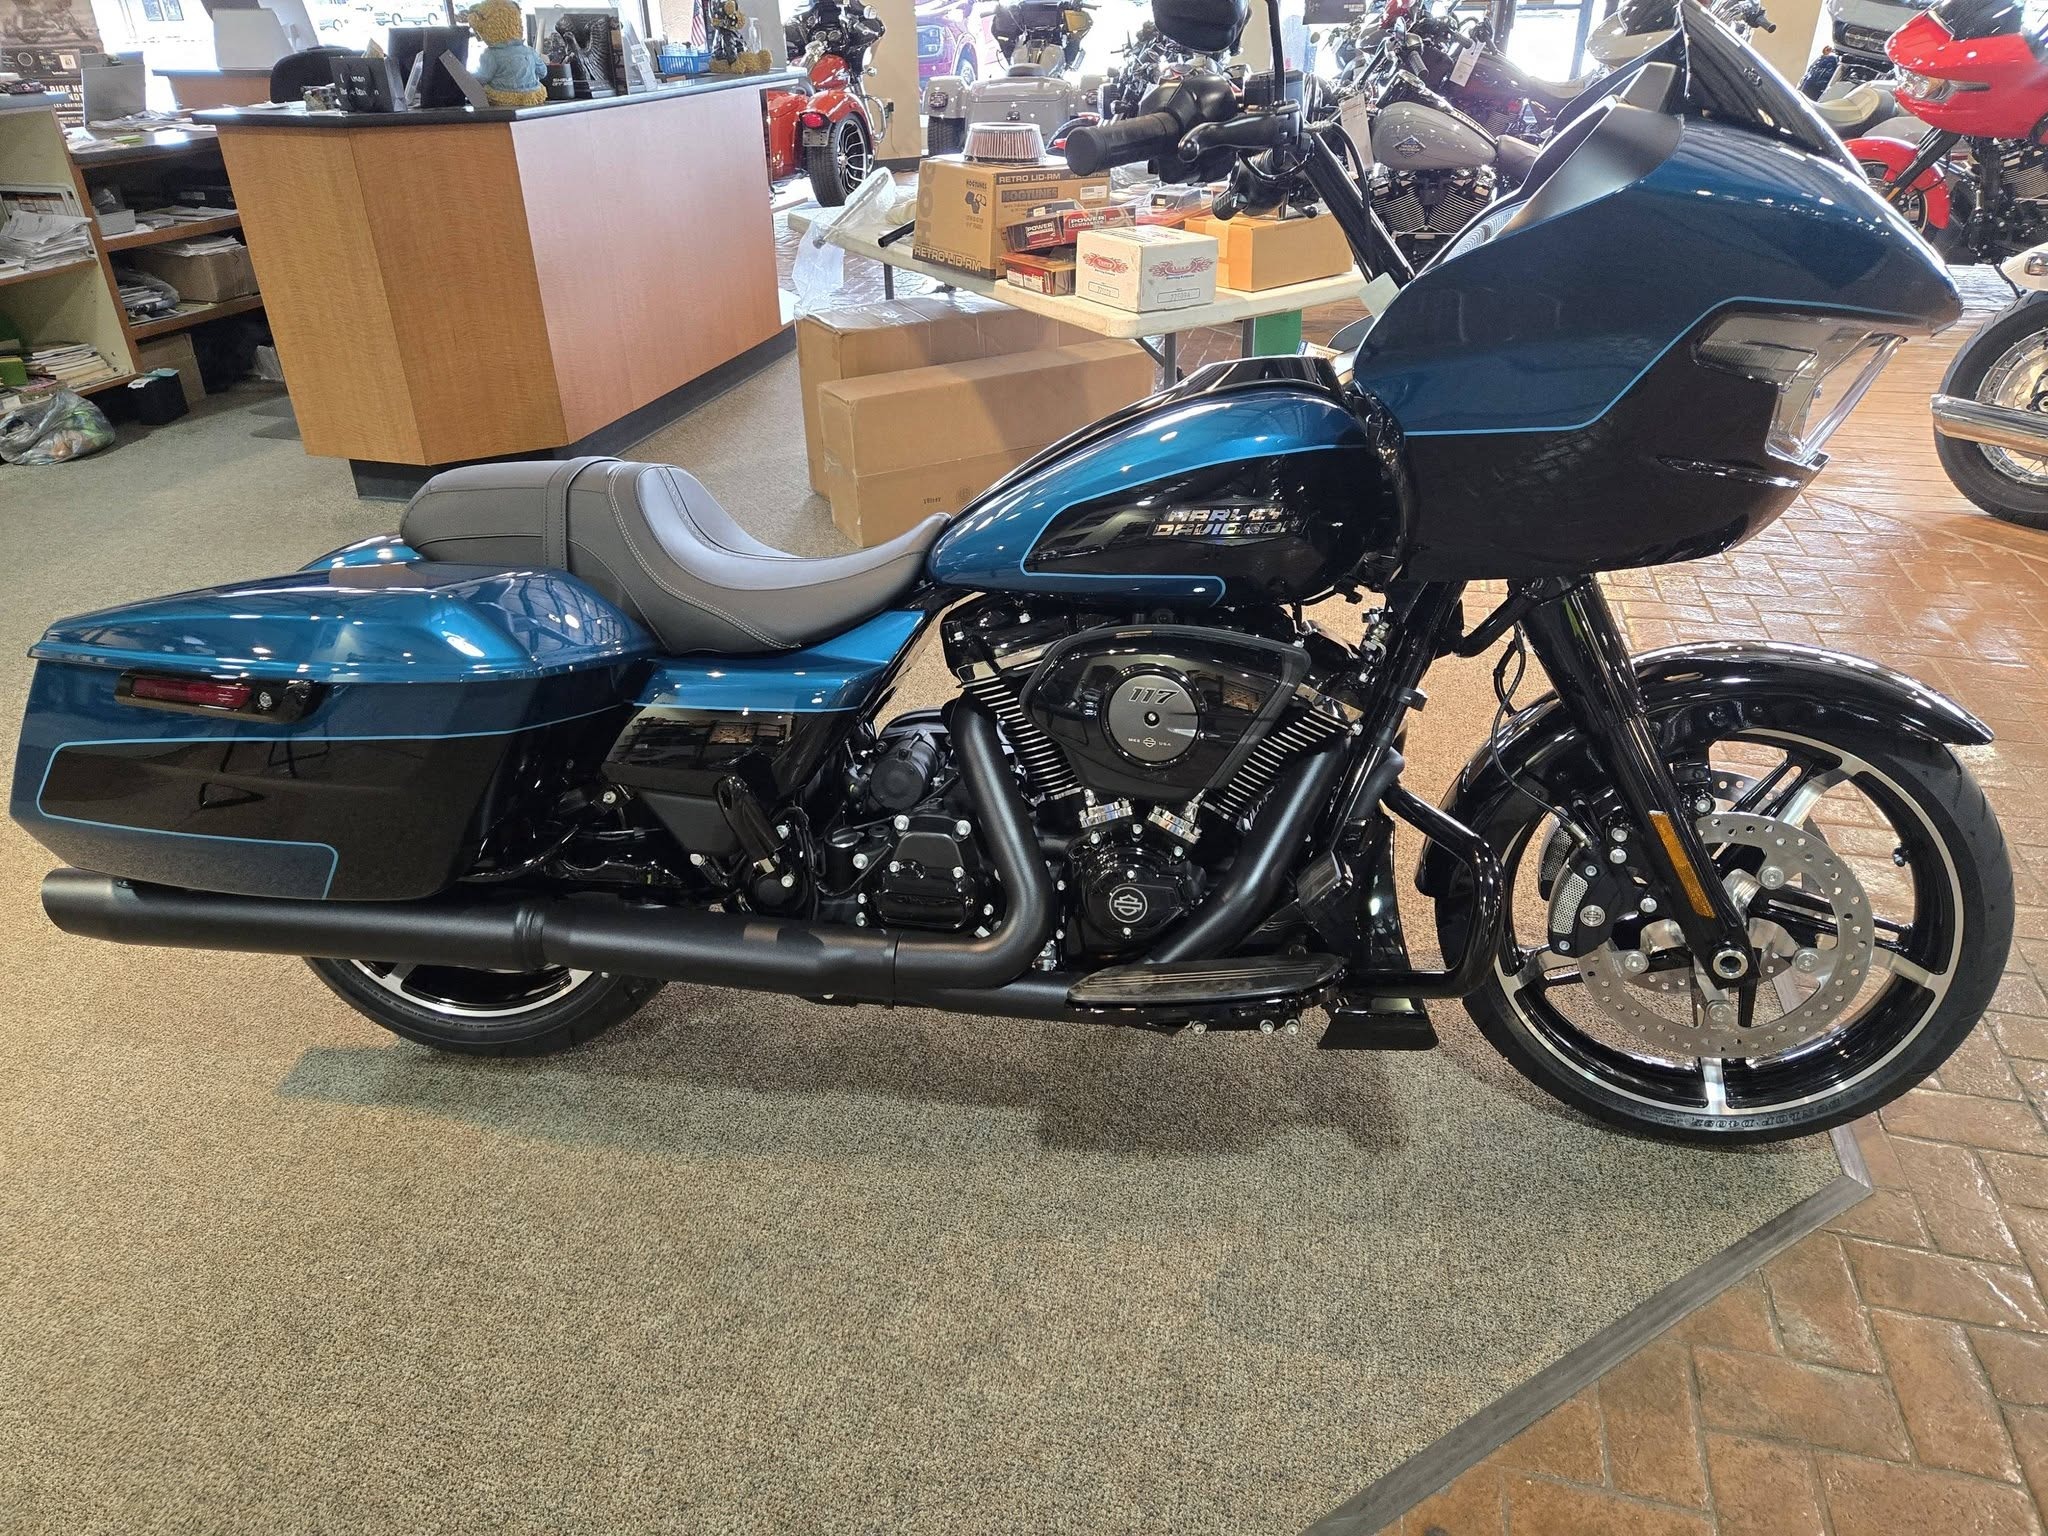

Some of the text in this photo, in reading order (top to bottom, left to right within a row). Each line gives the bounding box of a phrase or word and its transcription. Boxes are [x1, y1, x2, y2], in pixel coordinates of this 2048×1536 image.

[999, 175, 1029, 184] RETRO
[1031, 173, 1061, 182] LID-RM
[1002, 187, 1058, 202] HOGTUNES
[1070, 215, 1106, 224] POWER
[1026, 221, 1054, 233] POWER
[914, 244, 982, 272] RETRO LID-RM
[1167, 508, 1283, 522] HARLEY
[1152, 520, 1298, 536] DAVIDSON
[1128, 686, 1180, 705] 117
